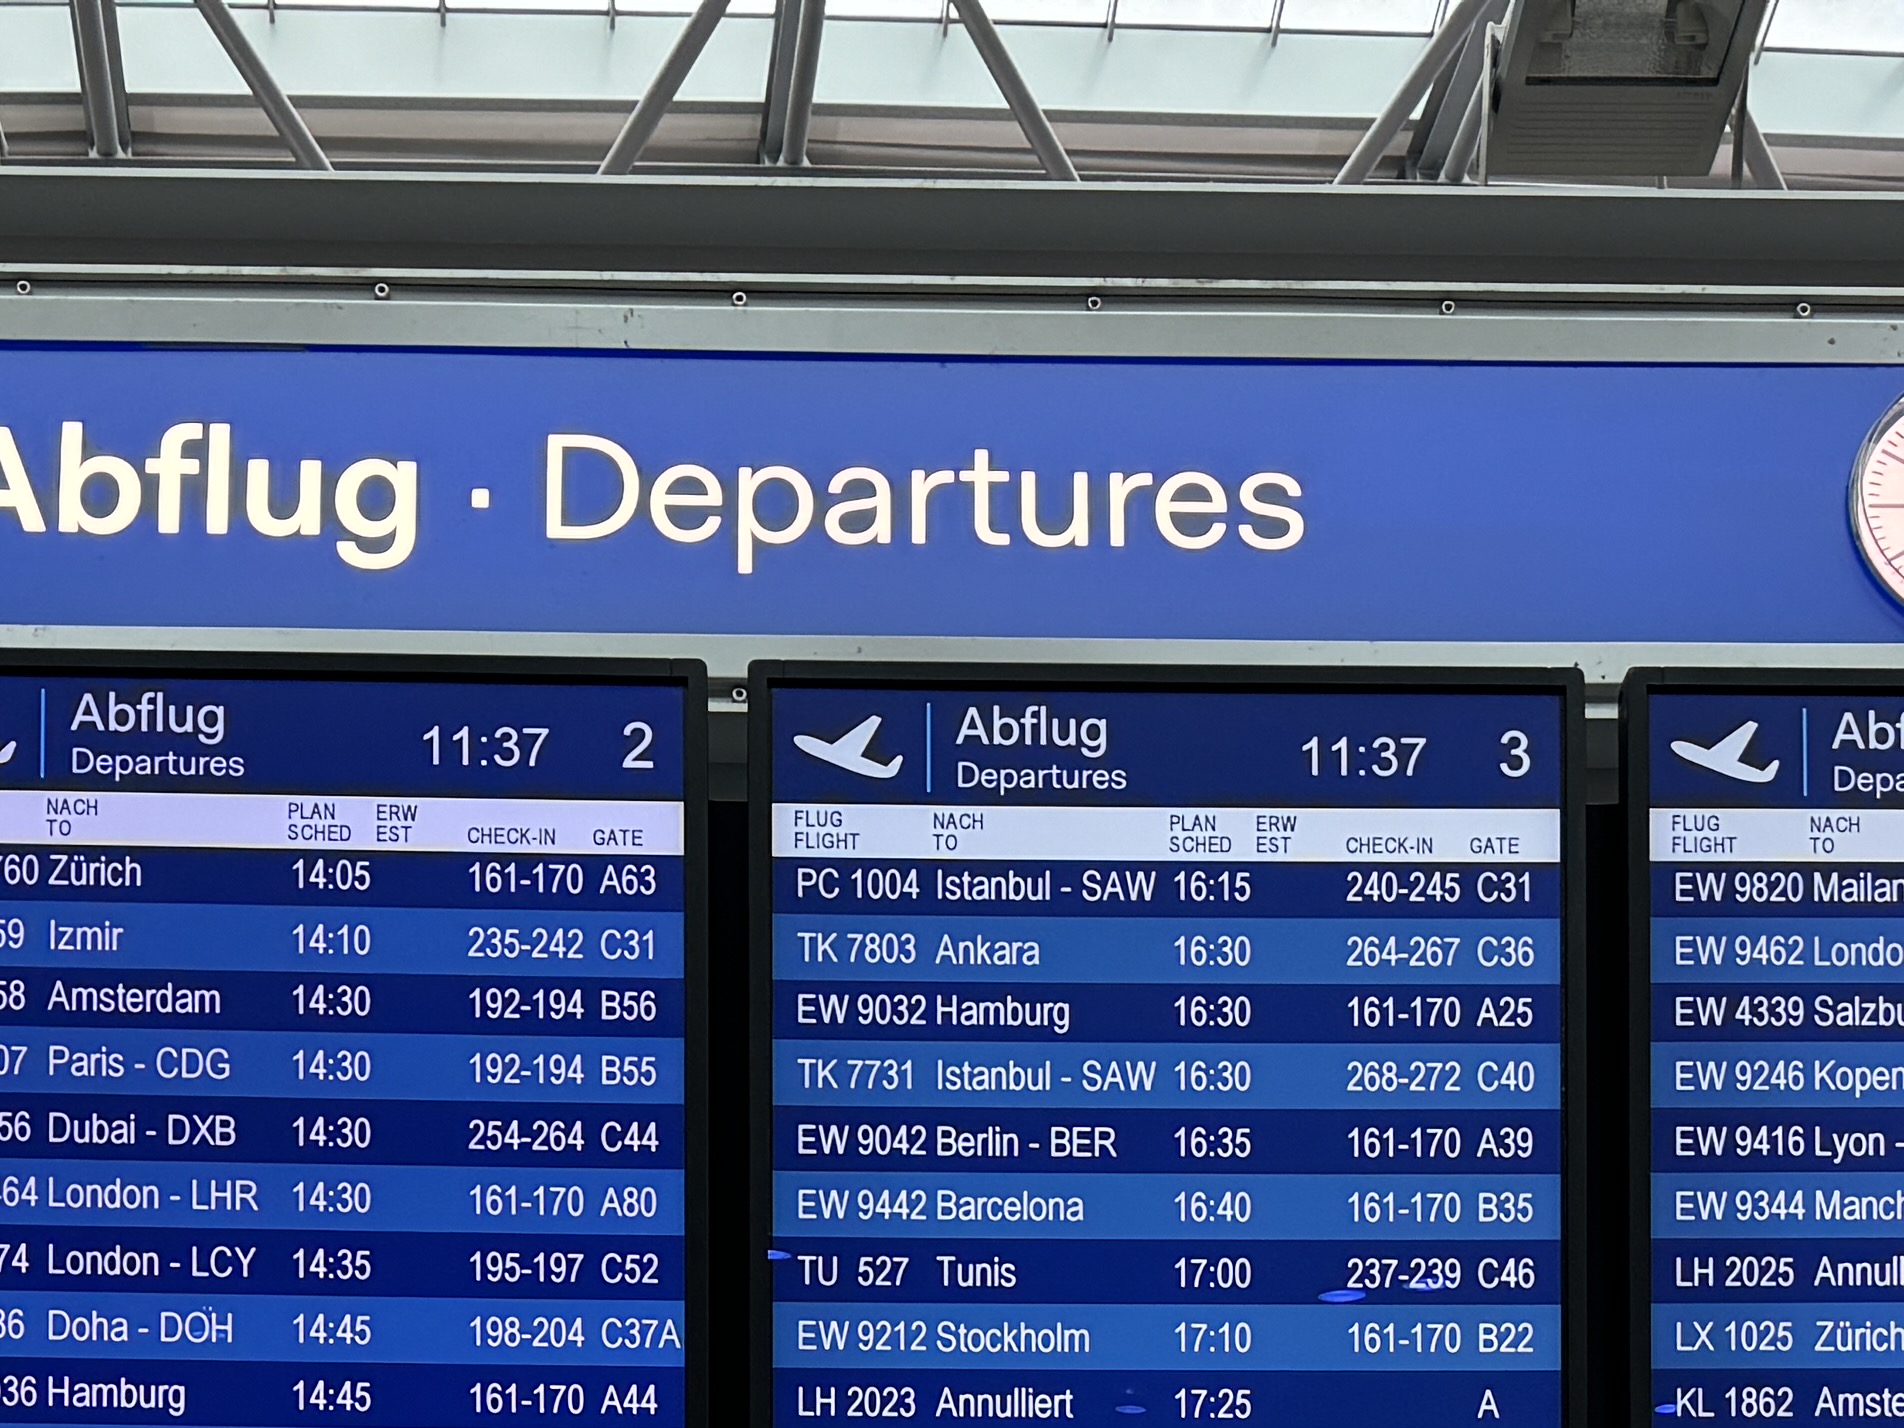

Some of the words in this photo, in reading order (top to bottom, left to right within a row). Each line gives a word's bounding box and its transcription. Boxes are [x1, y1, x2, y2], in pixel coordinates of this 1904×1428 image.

[546, 434, 1304, 574] Departures
[71, 692, 224, 744] Abflug
[956, 705, 1106, 757] Abflug
[73, 748, 244, 781] Departures
[423, 726, 549, 766] 11:37
[623, 722, 653, 768] 2
[1303, 737, 1426, 776] 11:37
[1500, 731, 1530, 777] 3
[958, 762, 1126, 795] Departures
[796, 932, 838, 963] TK
[846, 932, 916, 964] 7803
[935, 933, 1040, 966] Ankara
[1174, 935, 1251, 967] 16:30
[1346, 935, 1461, 967] 264-267
[1477, 936, 1535, 968] C36
[47, 980, 221, 1014] Amsterdam
[292, 984, 371, 1017] 14:30
[469, 987, 585, 1020] 192-194
[601, 989, 657, 1022] B56
[1675, 1060, 1728, 1091] EW
[1735, 1059, 1805, 1091] 9246
